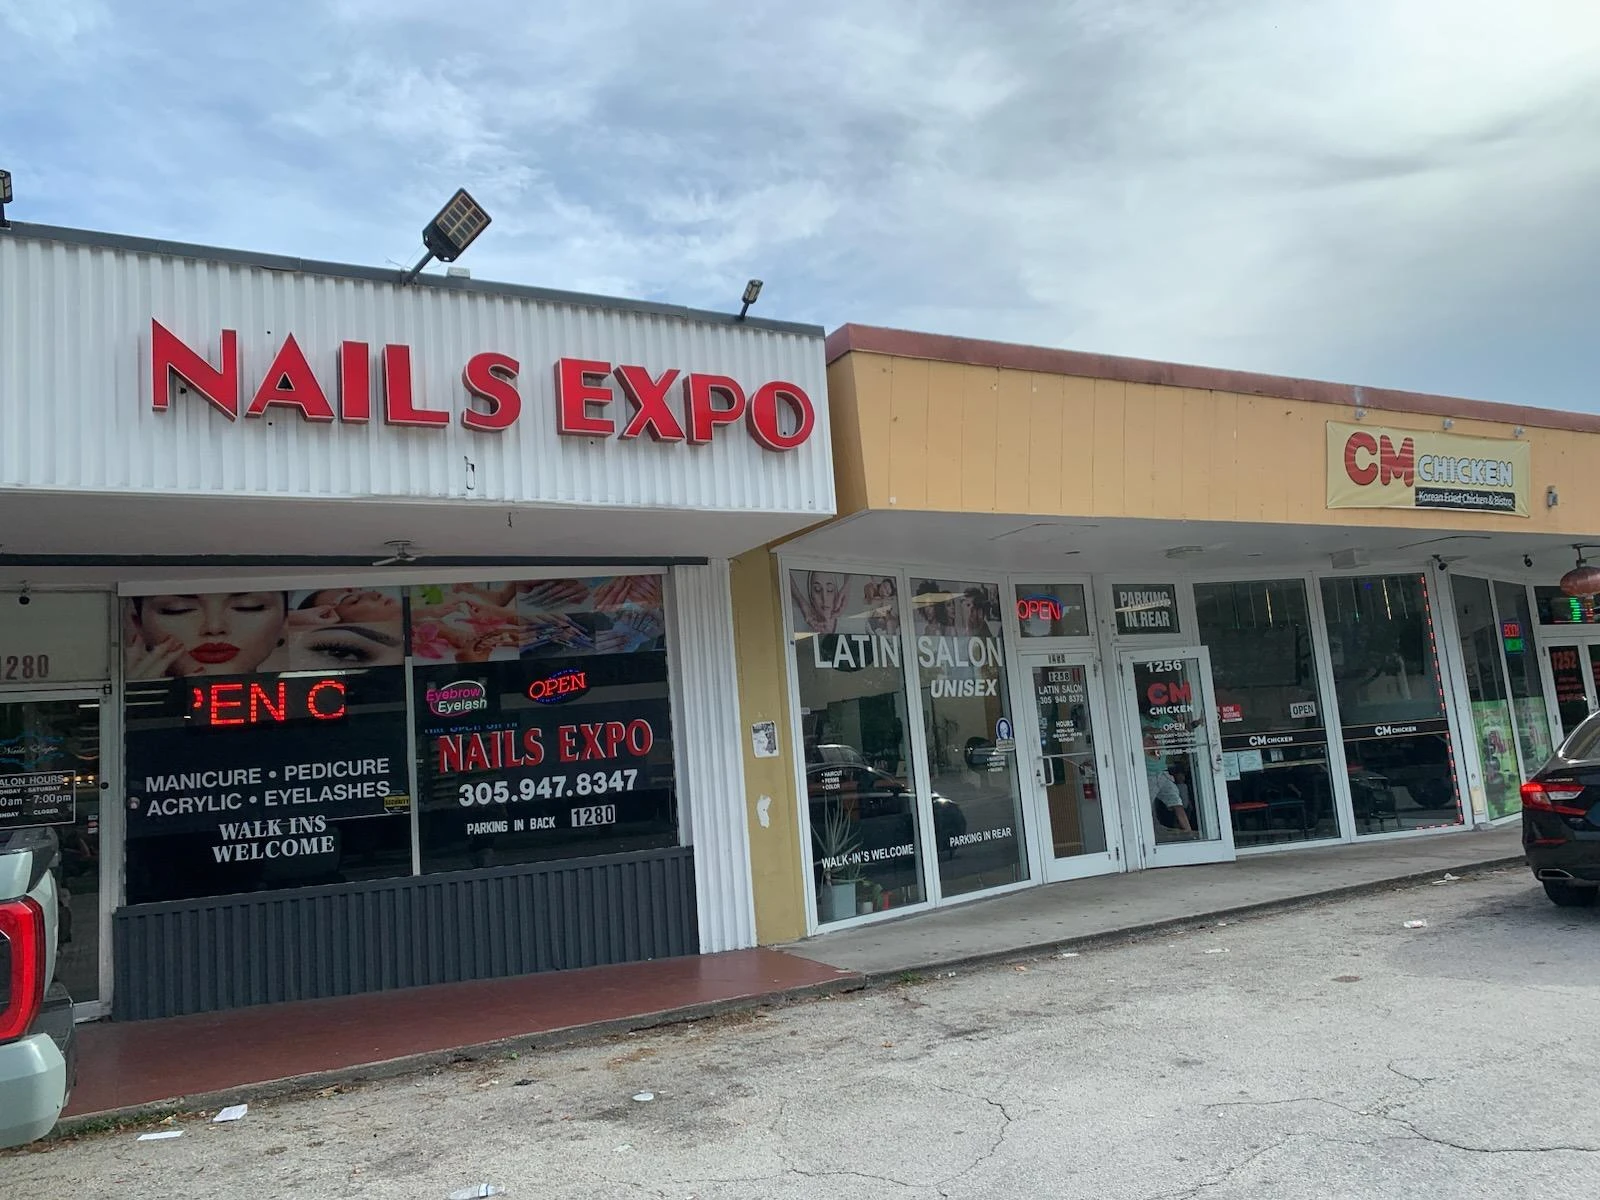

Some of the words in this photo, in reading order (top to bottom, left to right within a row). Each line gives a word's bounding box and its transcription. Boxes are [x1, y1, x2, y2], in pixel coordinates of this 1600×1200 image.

[151, 317, 521, 432] NAILS
[554, 357, 815, 452] EXPO
[1344, 431, 1415, 487] CM
[1417, 455, 1513, 487] CHICKEN
[1419, 491, 1444, 503] Korean
[1444, 492, 1462, 504] Fried
[1463, 494, 1488, 505] Chicken
[1494, 496, 1512, 506] Bistro
[1120, 592, 1169, 607] PARKING
[1017, 600, 1061, 621] OPEN
[1125, 612, 1138, 627] IN
[1140, 611, 1170, 627] REAR
[813, 634, 900, 668] LATIN
[918, 635, 1004, 669] SALON
[0, 654, 48, 680] 280
[1146, 659, 1183, 673] 1256
[426, 687, 481, 703] Eyebrow
[529, 672, 587, 699] OPEN
[930, 679, 997, 698] UNISEX
[1038, 685, 1060, 695] LATIN
[1062, 684, 1082, 694] SALON
[1147, 680, 1193, 705] CM
[438, 698, 487, 714] Eyelash
[1150, 704, 1193, 715] CHICKEN
[1293, 704, 1314, 715] OPEN
[1163, 722, 1186, 731] OPEN
[1375, 725, 1392, 737] CM
[1392, 726, 1417, 734] CHICKEN
[437, 728, 545, 774] NAILS
[559, 718, 653, 762] EXPO
[1249, 735, 1267, 746] CM
[1267, 736, 1294, 744] CHICKEN
[30, 775, 64, 785] HOURS
[146, 768, 262, 793] MANICURE
[284, 758, 390, 782] PEDICURE
[458, 769, 638, 807] 305.947.8347
[33, 794, 72, 804] 7:00pm
[146, 792, 242, 817] ACRYLIC
[264, 780, 391, 807] EYELASHES
[573, 805, 615, 826] 1280
[219, 819, 282, 841] WALK
[289, 815, 327, 836] INS
[467, 820, 508, 835] PARKING
[514, 818, 524, 832] IN
[530, 816, 556, 830] BACK
[950, 832, 982, 847] PARKING
[984, 830, 992, 842] IN
[992, 828, 1012, 840] REAR
[212, 836, 335, 863] WELCOME
[822, 852, 870, 869] WALK-IN'S
[871, 844, 914, 860] WELCOME
